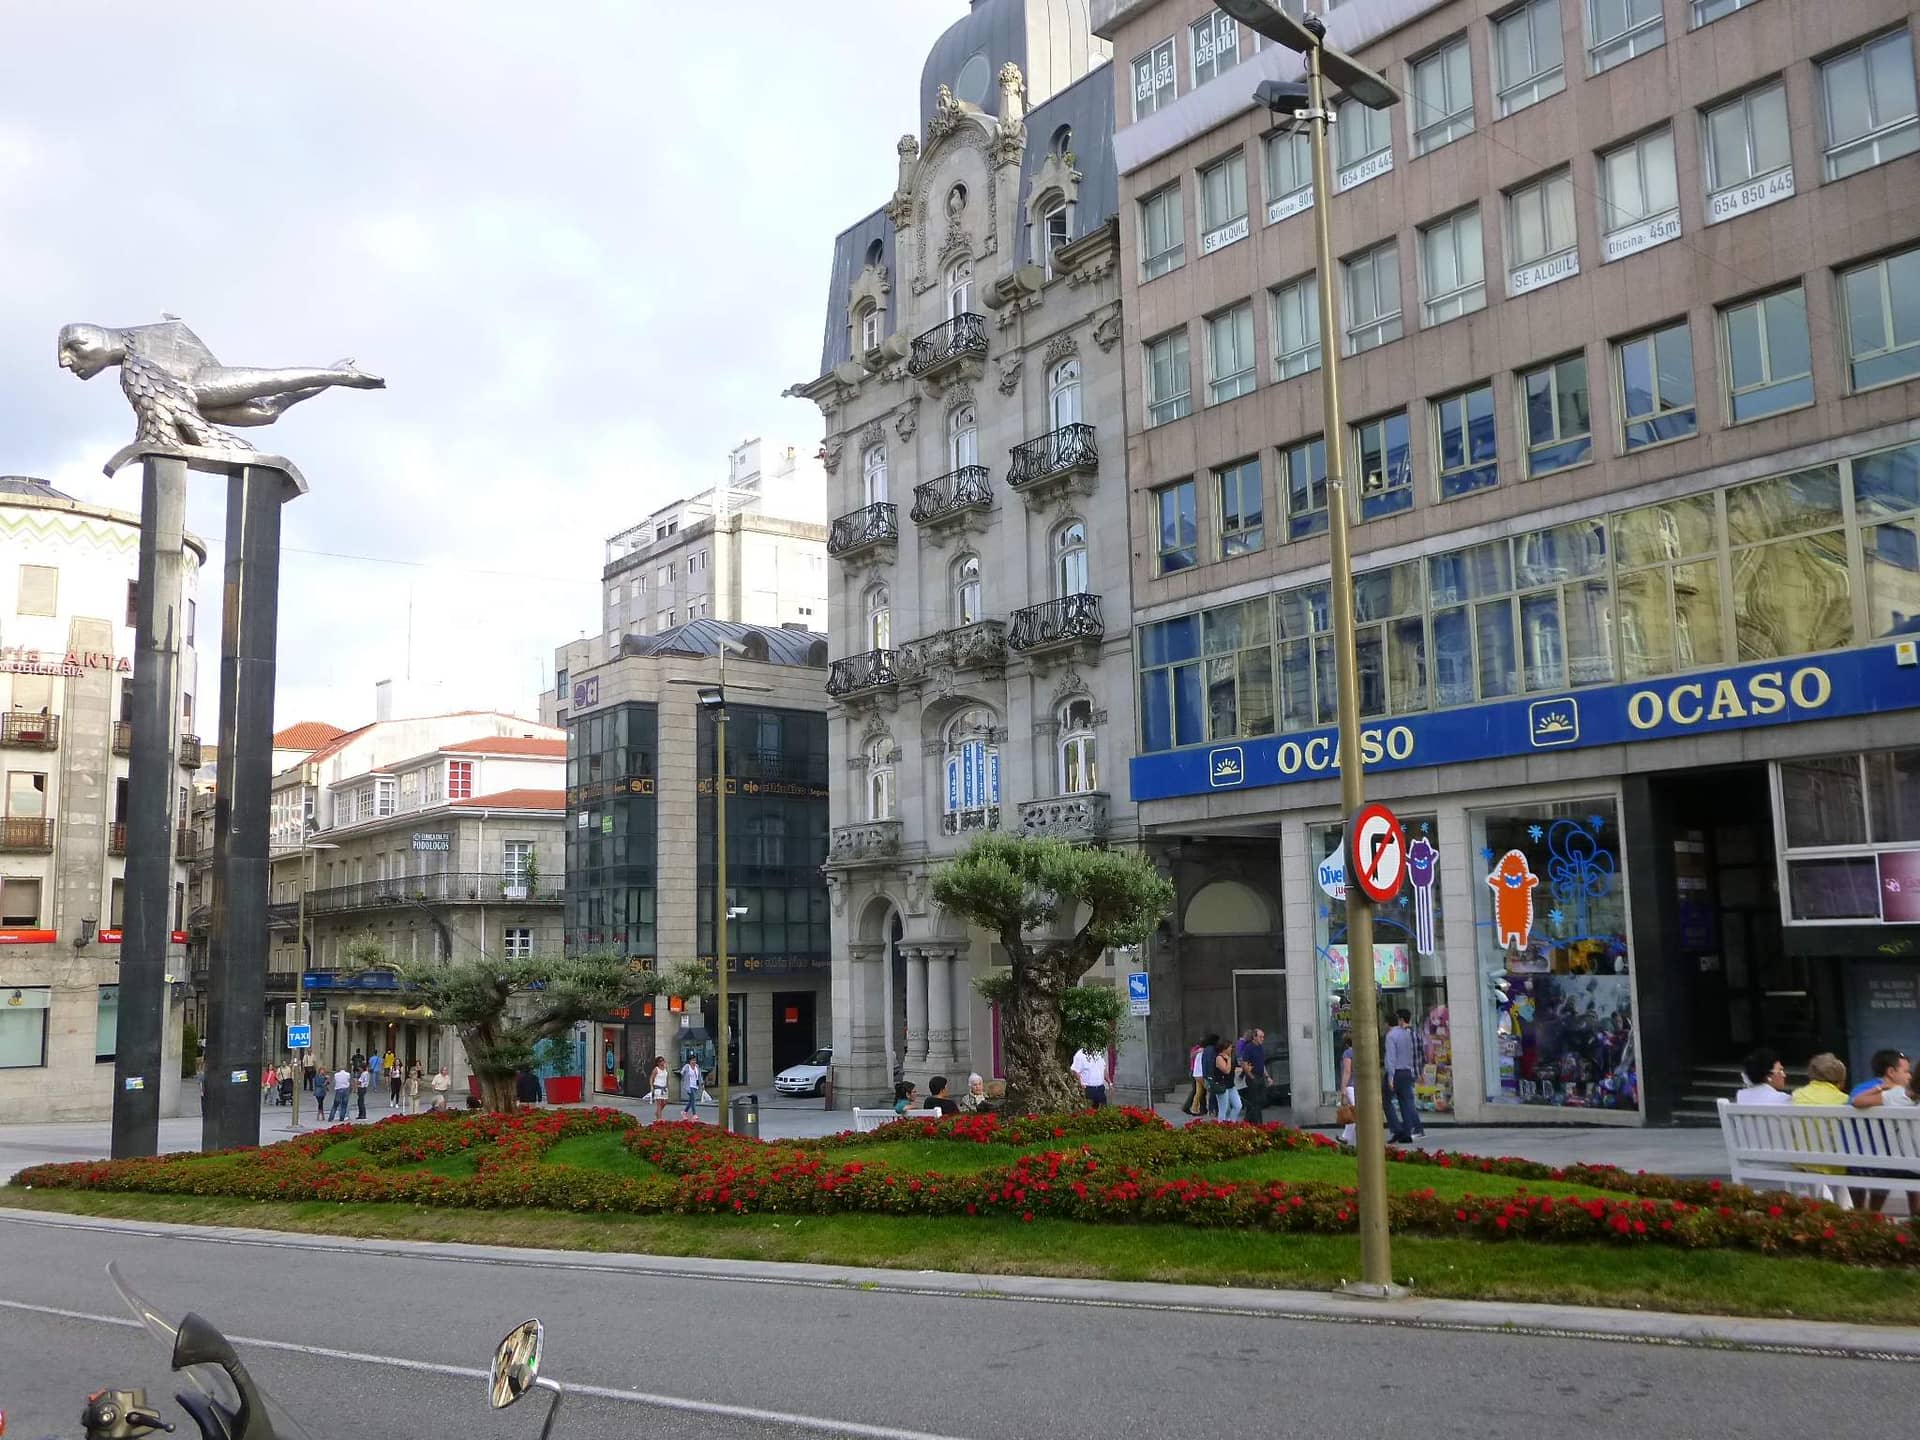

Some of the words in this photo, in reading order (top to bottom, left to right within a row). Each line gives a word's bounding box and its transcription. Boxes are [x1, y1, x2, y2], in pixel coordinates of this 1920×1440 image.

[1713, 197, 1738, 215] 654
[1742, 183, 1765, 206] 850
[1769, 172, 1793, 194] 445
[1205, 235, 1217, 250] SE
[1514, 272, 1529, 289] SE
[1628, 666, 1832, 730] OCASO
[289, 1032, 310, 1042] TAXI
